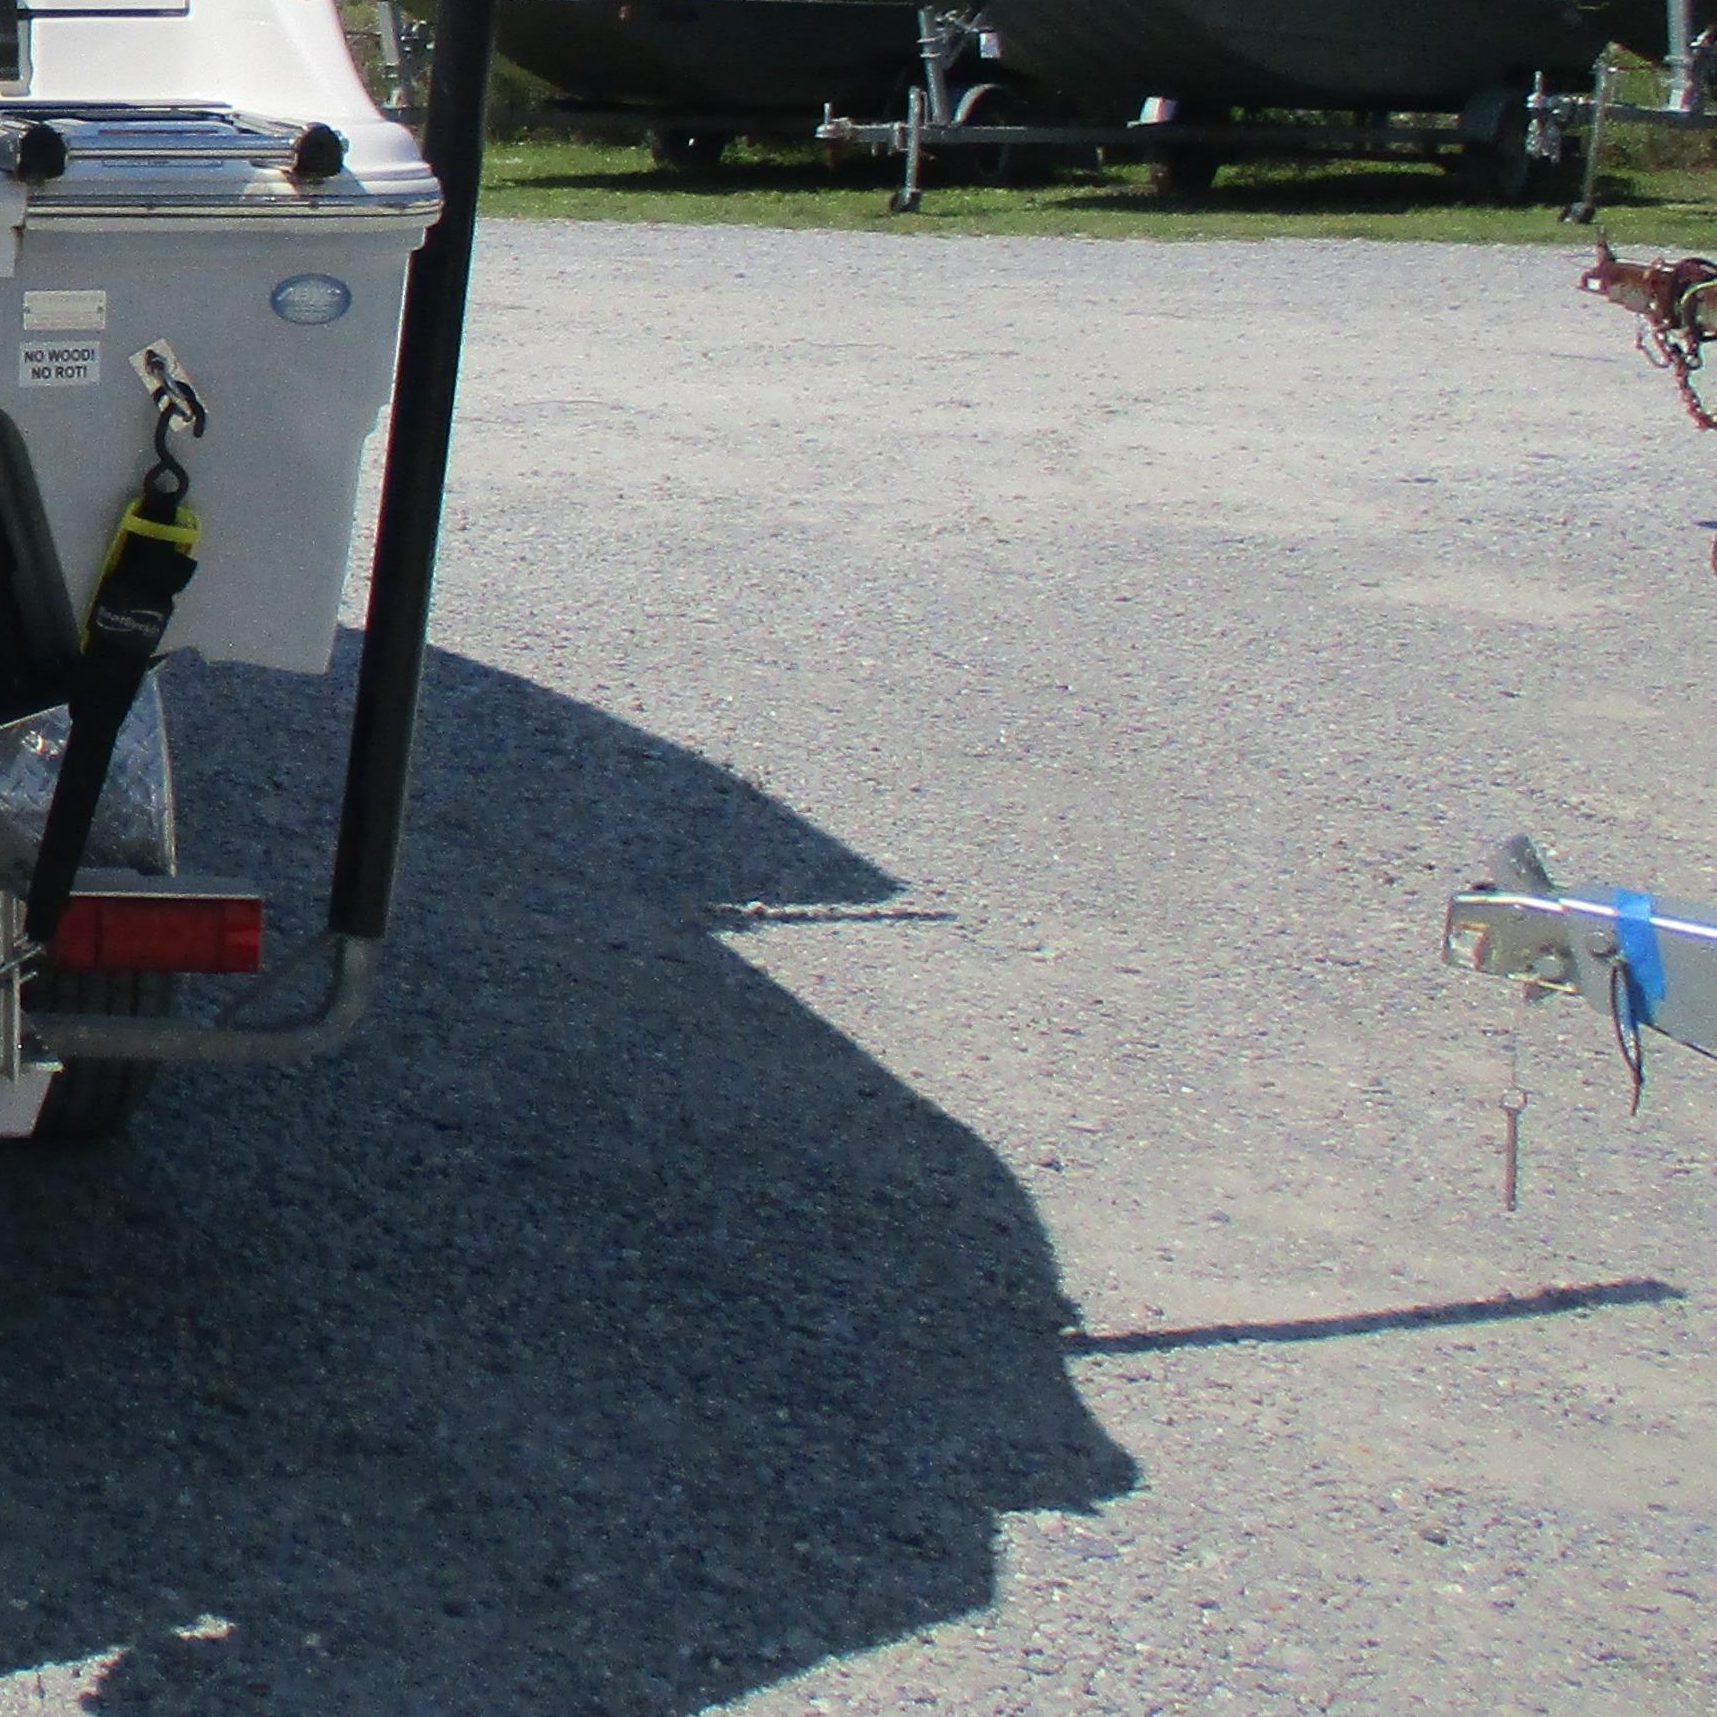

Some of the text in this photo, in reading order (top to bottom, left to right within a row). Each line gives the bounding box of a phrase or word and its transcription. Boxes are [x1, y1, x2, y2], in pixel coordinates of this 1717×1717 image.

[24, 348, 96, 363] NO WOOD!
[30, 366, 52, 380] NO
